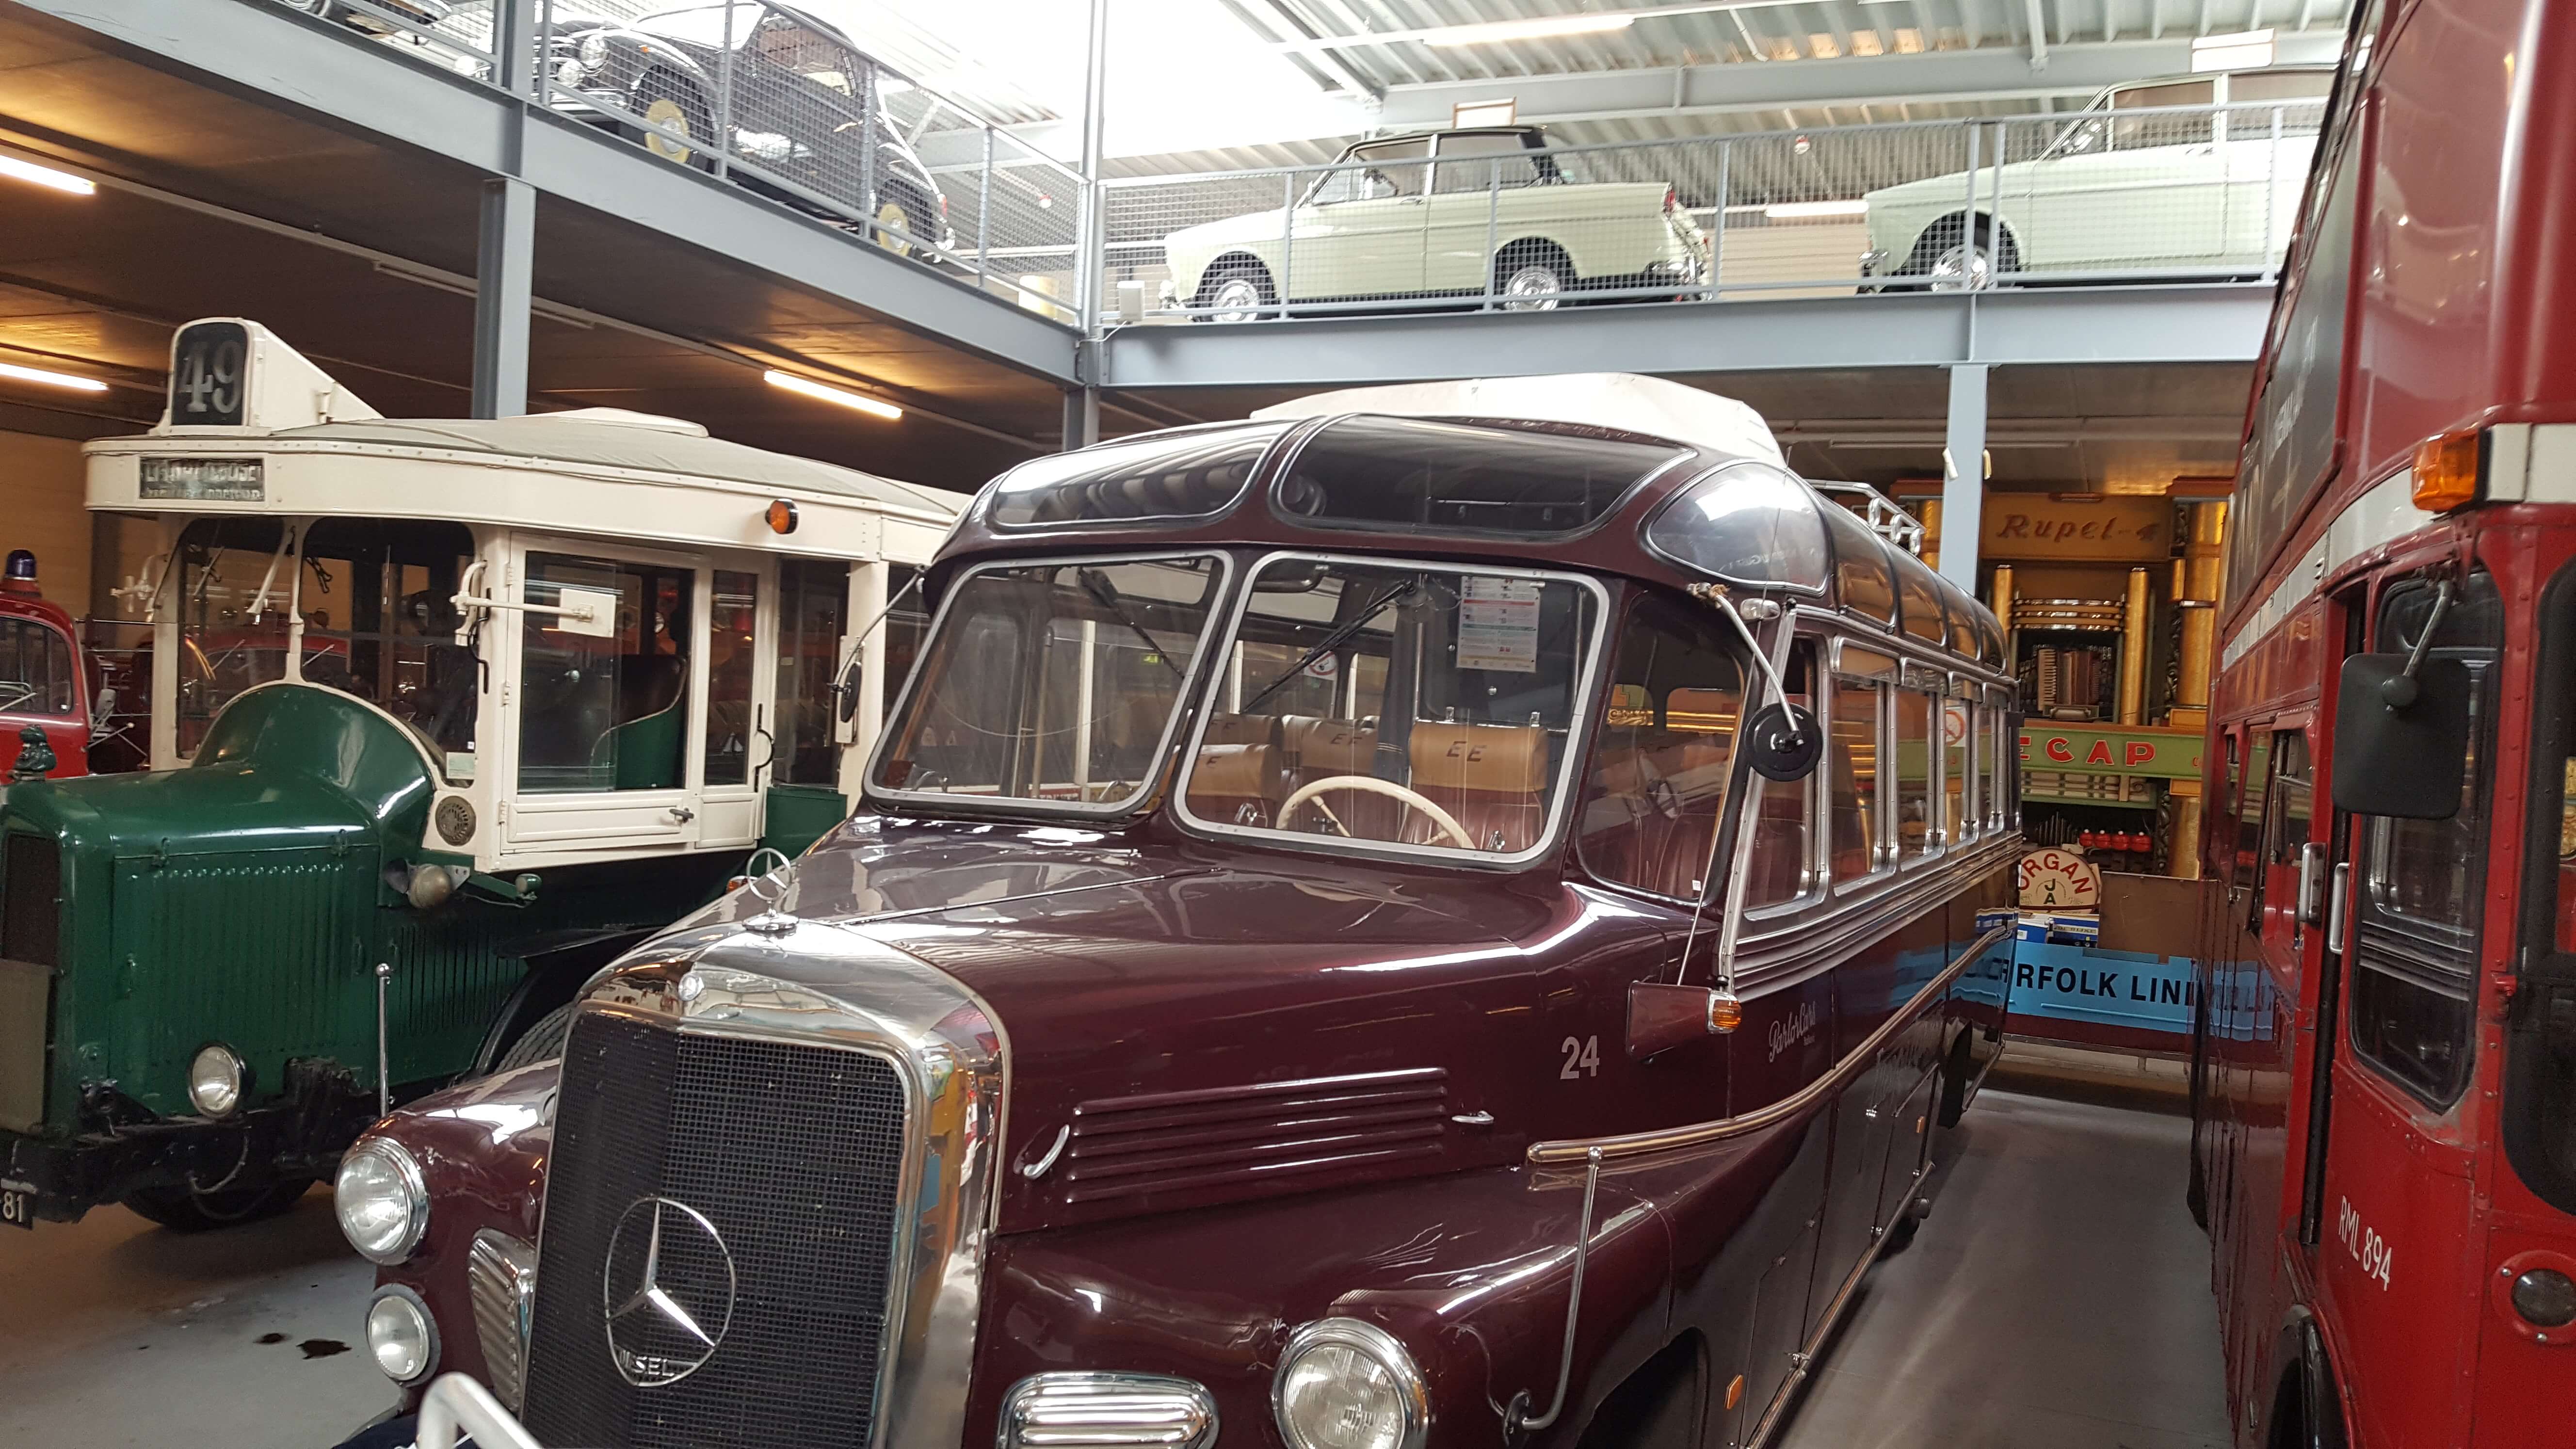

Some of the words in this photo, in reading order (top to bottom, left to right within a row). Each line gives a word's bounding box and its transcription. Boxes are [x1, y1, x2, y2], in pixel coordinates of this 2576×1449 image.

[178, 341, 243, 414] 49
[2021, 853, 2093, 895] ORGAN
[2045, 878, 2056, 891] J
[2043, 892, 2057, 905] A
[1560, 1035, 1600, 1079] 24
[2338, 1195, 2360, 1261] RML
[2363, 1226, 2392, 1291] 894
